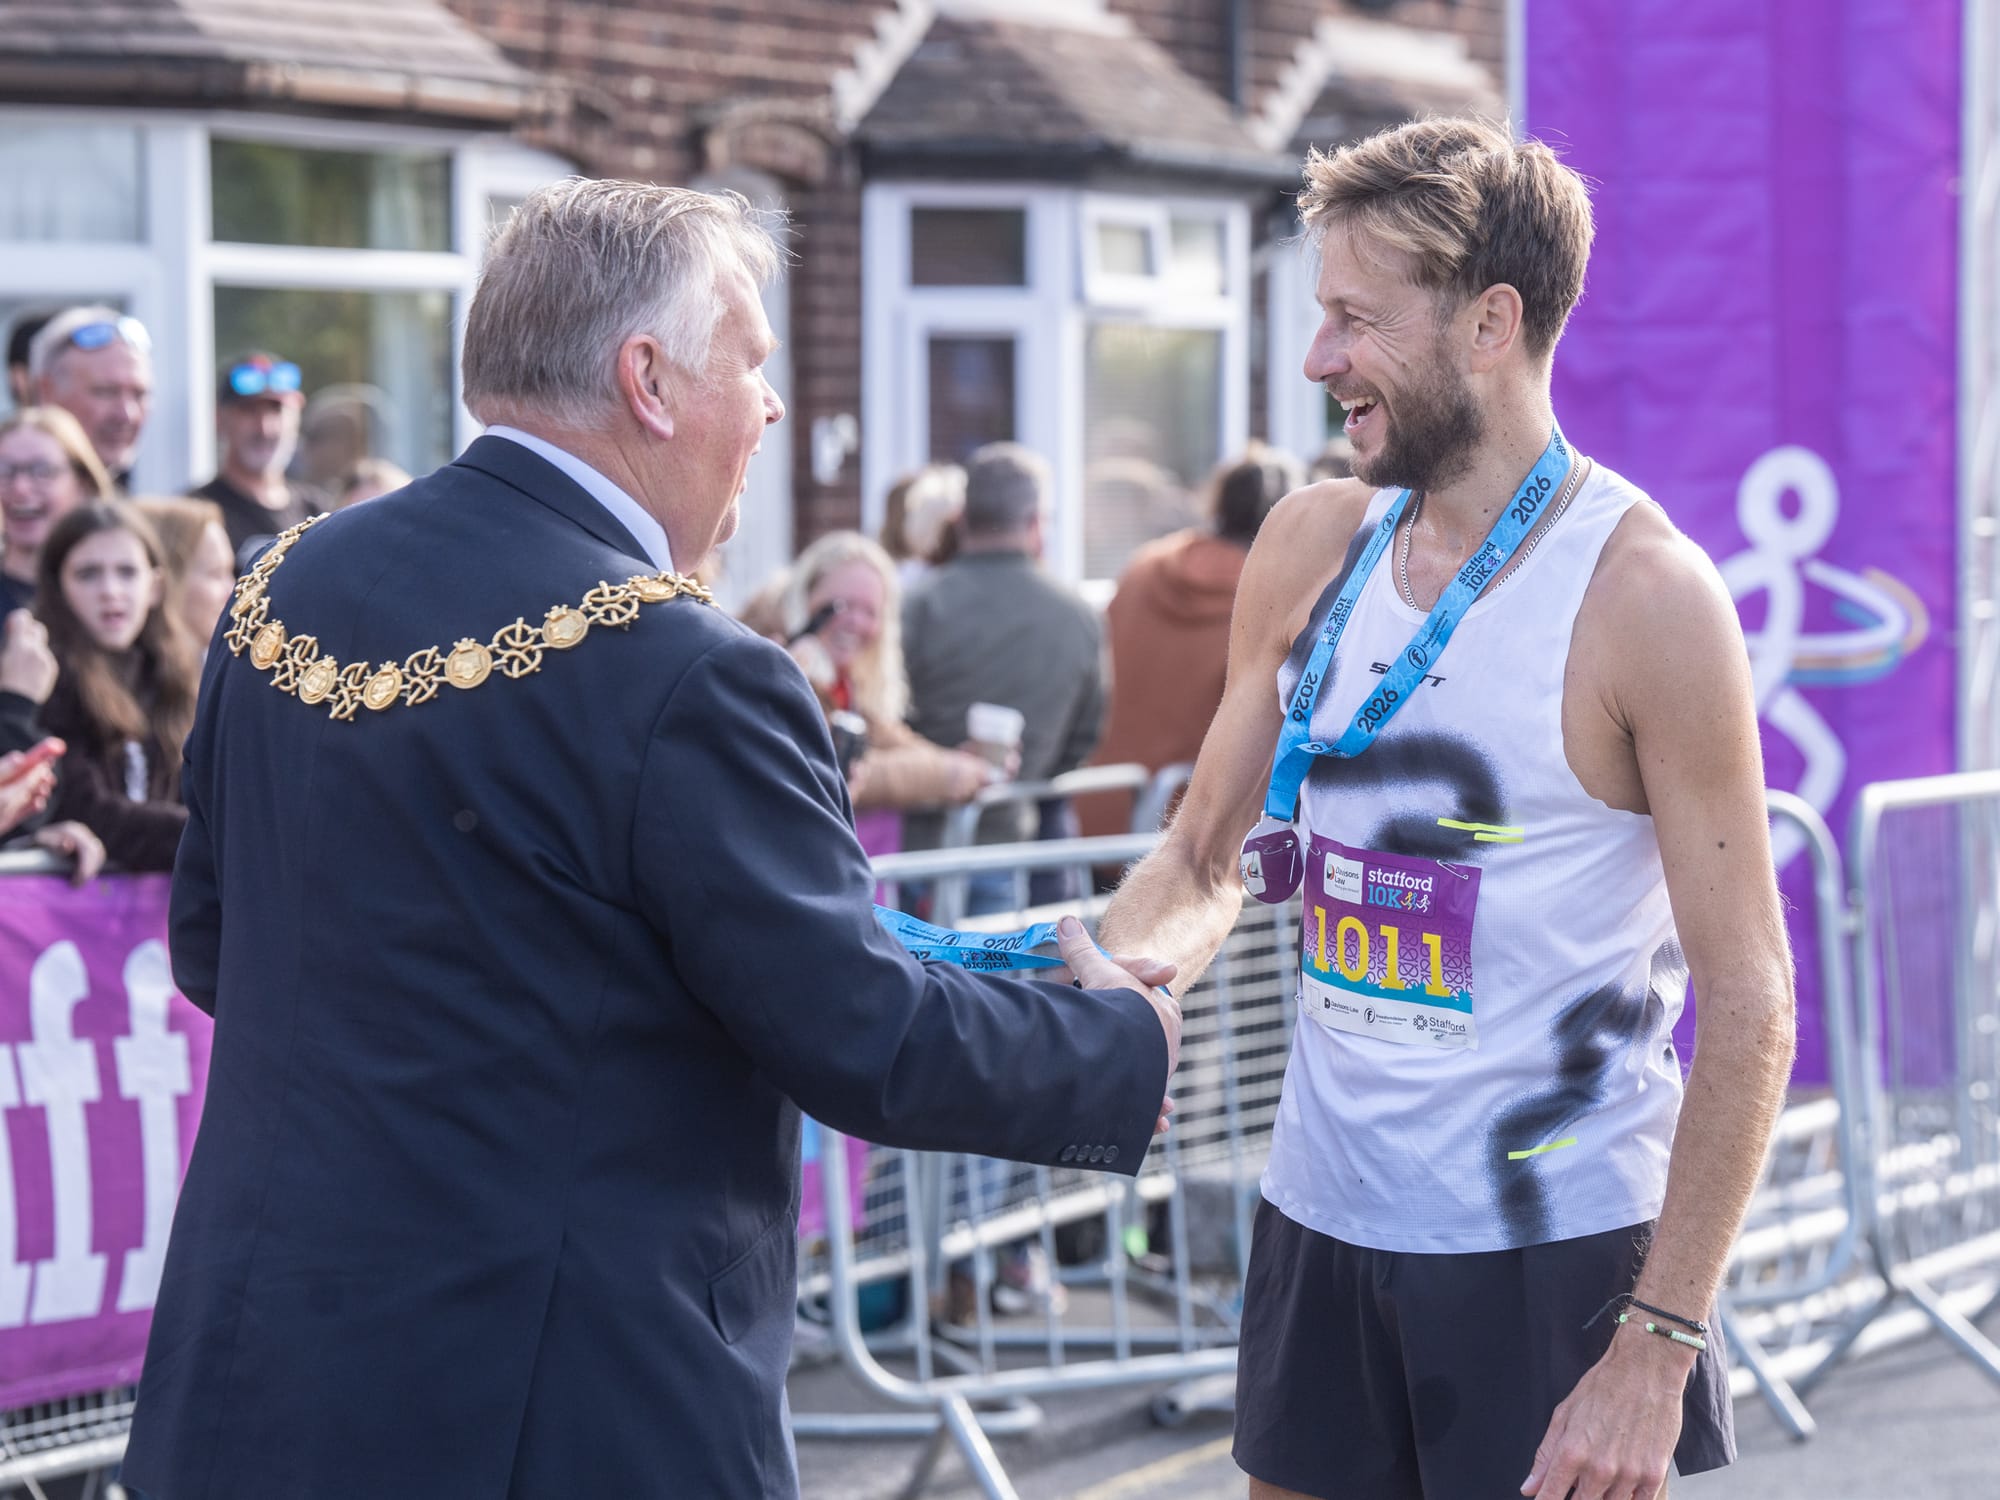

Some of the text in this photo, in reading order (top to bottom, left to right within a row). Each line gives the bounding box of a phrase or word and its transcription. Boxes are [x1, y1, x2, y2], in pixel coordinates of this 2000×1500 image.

[1511, 475, 1551, 526] 2026
[1458, 541, 1497, 585] stafford
[1465, 563, 1493, 593] 10K
[1328, 596, 1347, 624] 10K
[1328, 598, 1353, 646] stafford
[1369, 661, 1447, 687] STT
[1292, 671, 1319, 722] 2026
[1357, 687, 1399, 733] 2026
[1334, 874, 1346, 886] Law
[1335, 865, 1360, 880] Davisons
[1368, 867, 1433, 892] stafford
[1367, 883, 1403, 909] 10K
[981, 951, 1009, 962] 10K
[1314, 904, 1451, 998] 1011
[1429, 1016, 1466, 1032] Stafford
[0, 938, 192, 1330] ff
